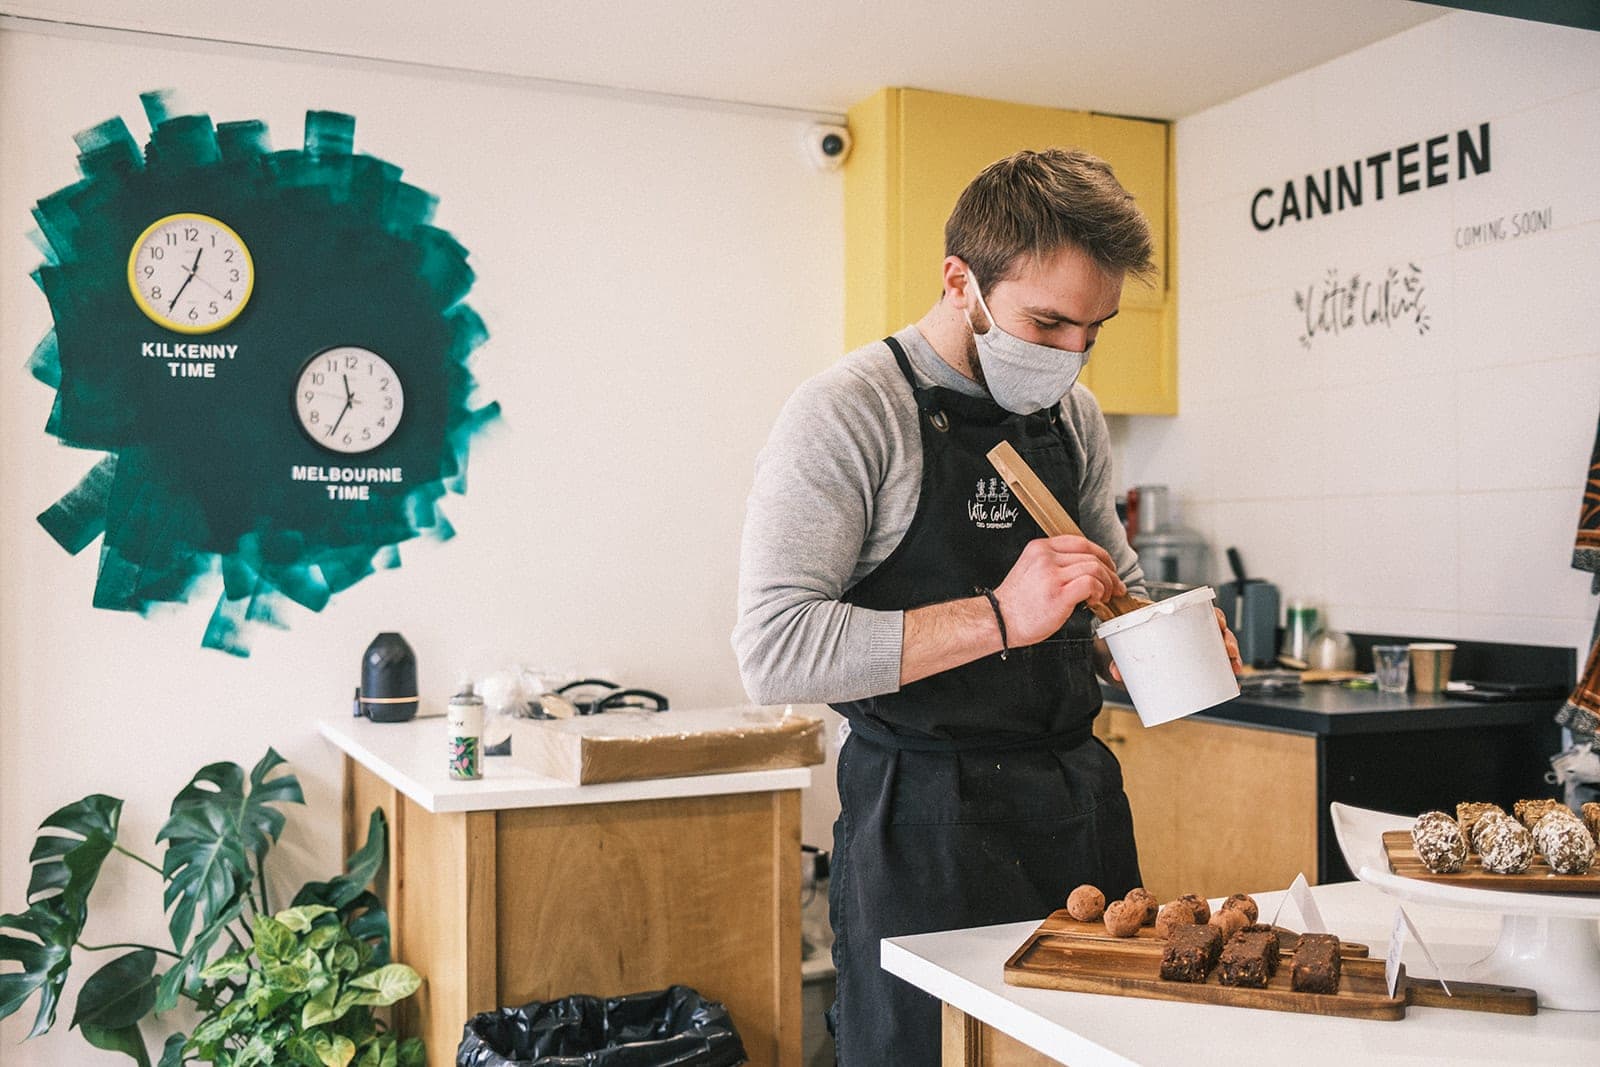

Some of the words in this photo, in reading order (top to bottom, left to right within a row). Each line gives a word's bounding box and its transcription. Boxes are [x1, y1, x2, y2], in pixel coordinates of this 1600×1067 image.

[1251, 122, 1491, 232] CANNTEEN
[166, 232, 177, 246] 11
[184, 228, 199, 242] 12
[1456, 217, 1505, 249] COMING
[210, 234, 216, 248] 1
[150, 246, 164, 260] 10
[223, 249, 234, 263] 2
[143, 265, 155, 279] 9
[229, 268, 240, 282] 3
[151, 286, 162, 300] 8
[223, 289, 233, 301] 4
[188, 306, 199, 320] 6
[208, 301, 219, 315] 5
[142, 342, 239, 360] KILKENNY
[327, 360, 338, 373] 11
[345, 356, 358, 369] 12
[167, 362, 217, 378] TIME
[368, 363, 374, 377] 1
[312, 372, 325, 386] 10
[379, 377, 390, 391] 2
[304, 390, 315, 404] 9
[384, 397, 393, 410] 3
[310, 411, 320, 424] 8
[376, 416, 385, 428] 4
[324, 423, 334, 438] 7
[361, 427, 371, 441] 5
[342, 432, 352, 445] 6
[292, 465, 403, 483] MELBOURNE
[326, 485, 370, 501] TIME
